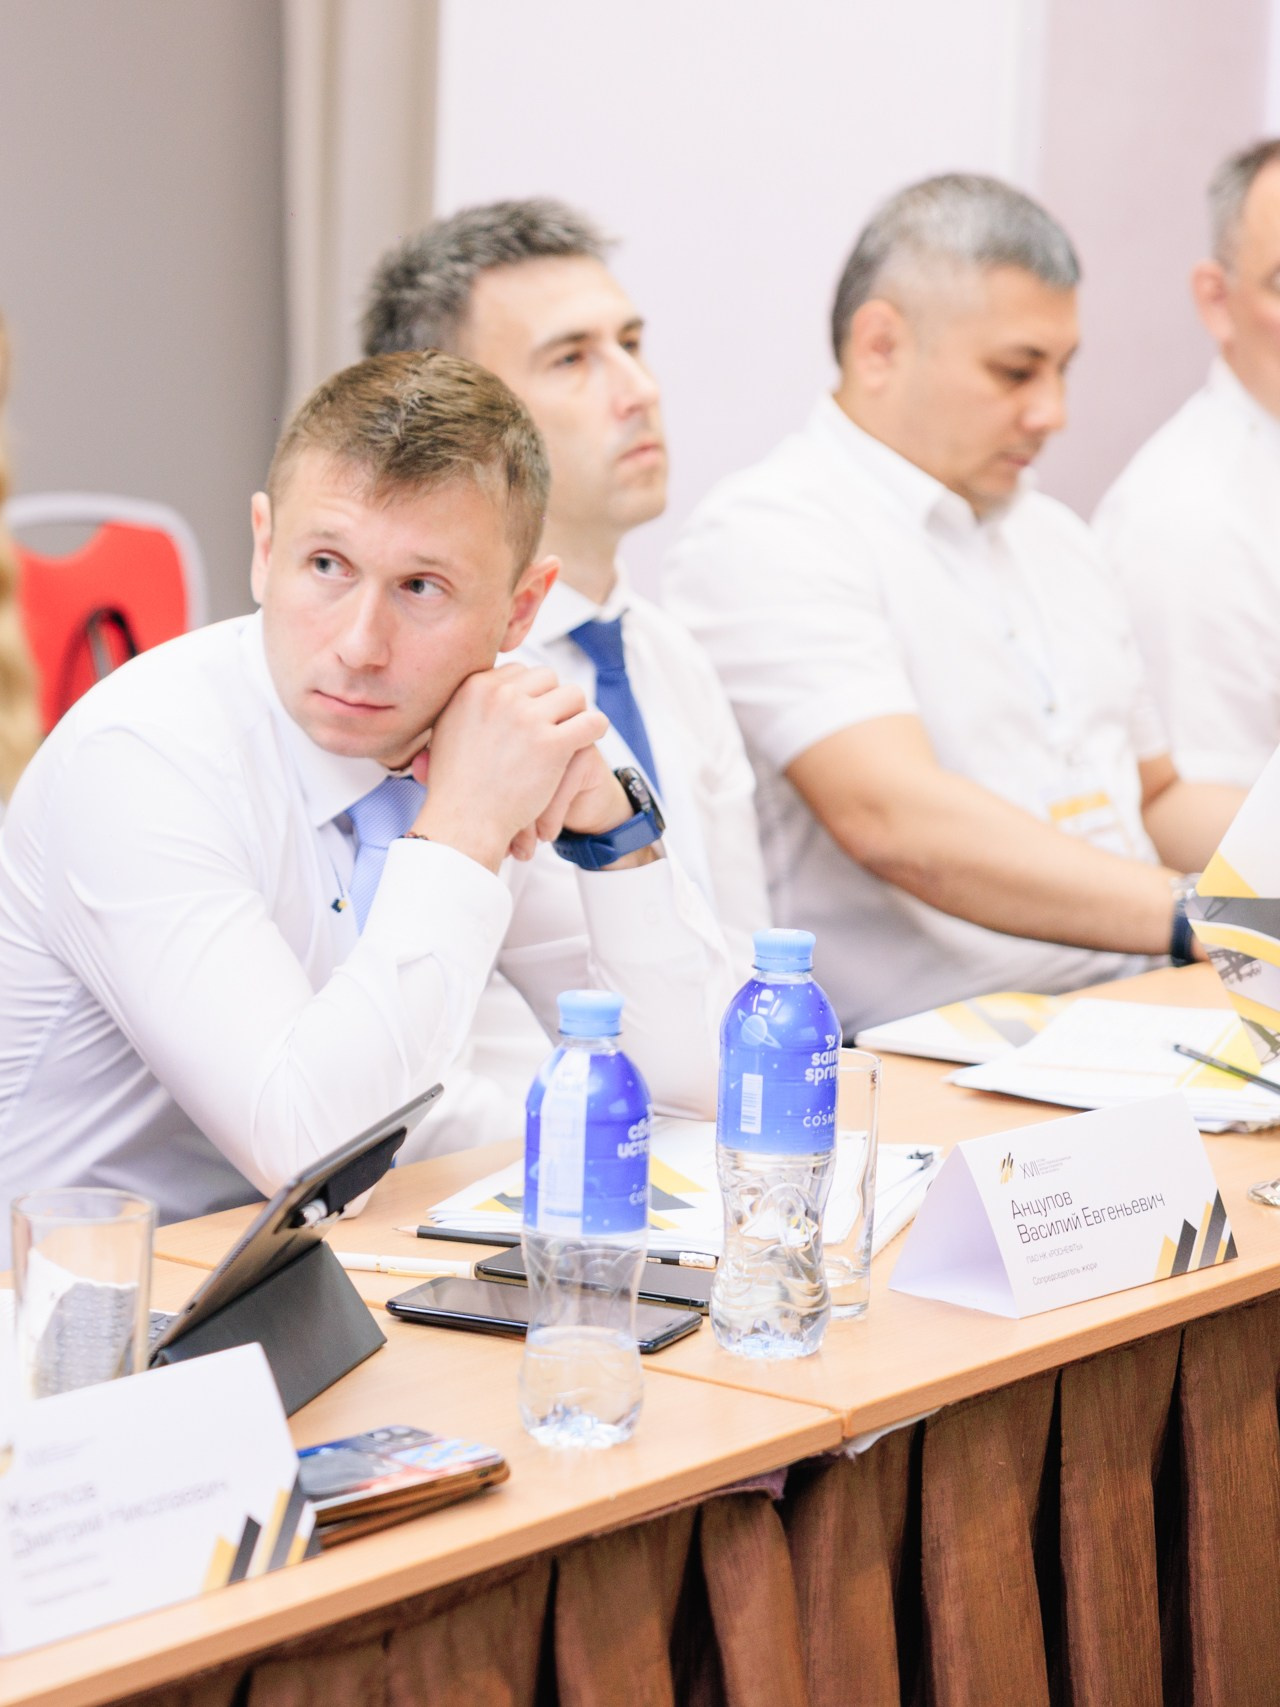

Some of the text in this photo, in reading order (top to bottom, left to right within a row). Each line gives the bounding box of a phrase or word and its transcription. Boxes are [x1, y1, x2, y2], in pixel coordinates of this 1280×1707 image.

[1011, 1191, 1073, 1219] Анцупов
[1017, 1193, 1166, 1244] Василий Евгеньевич
